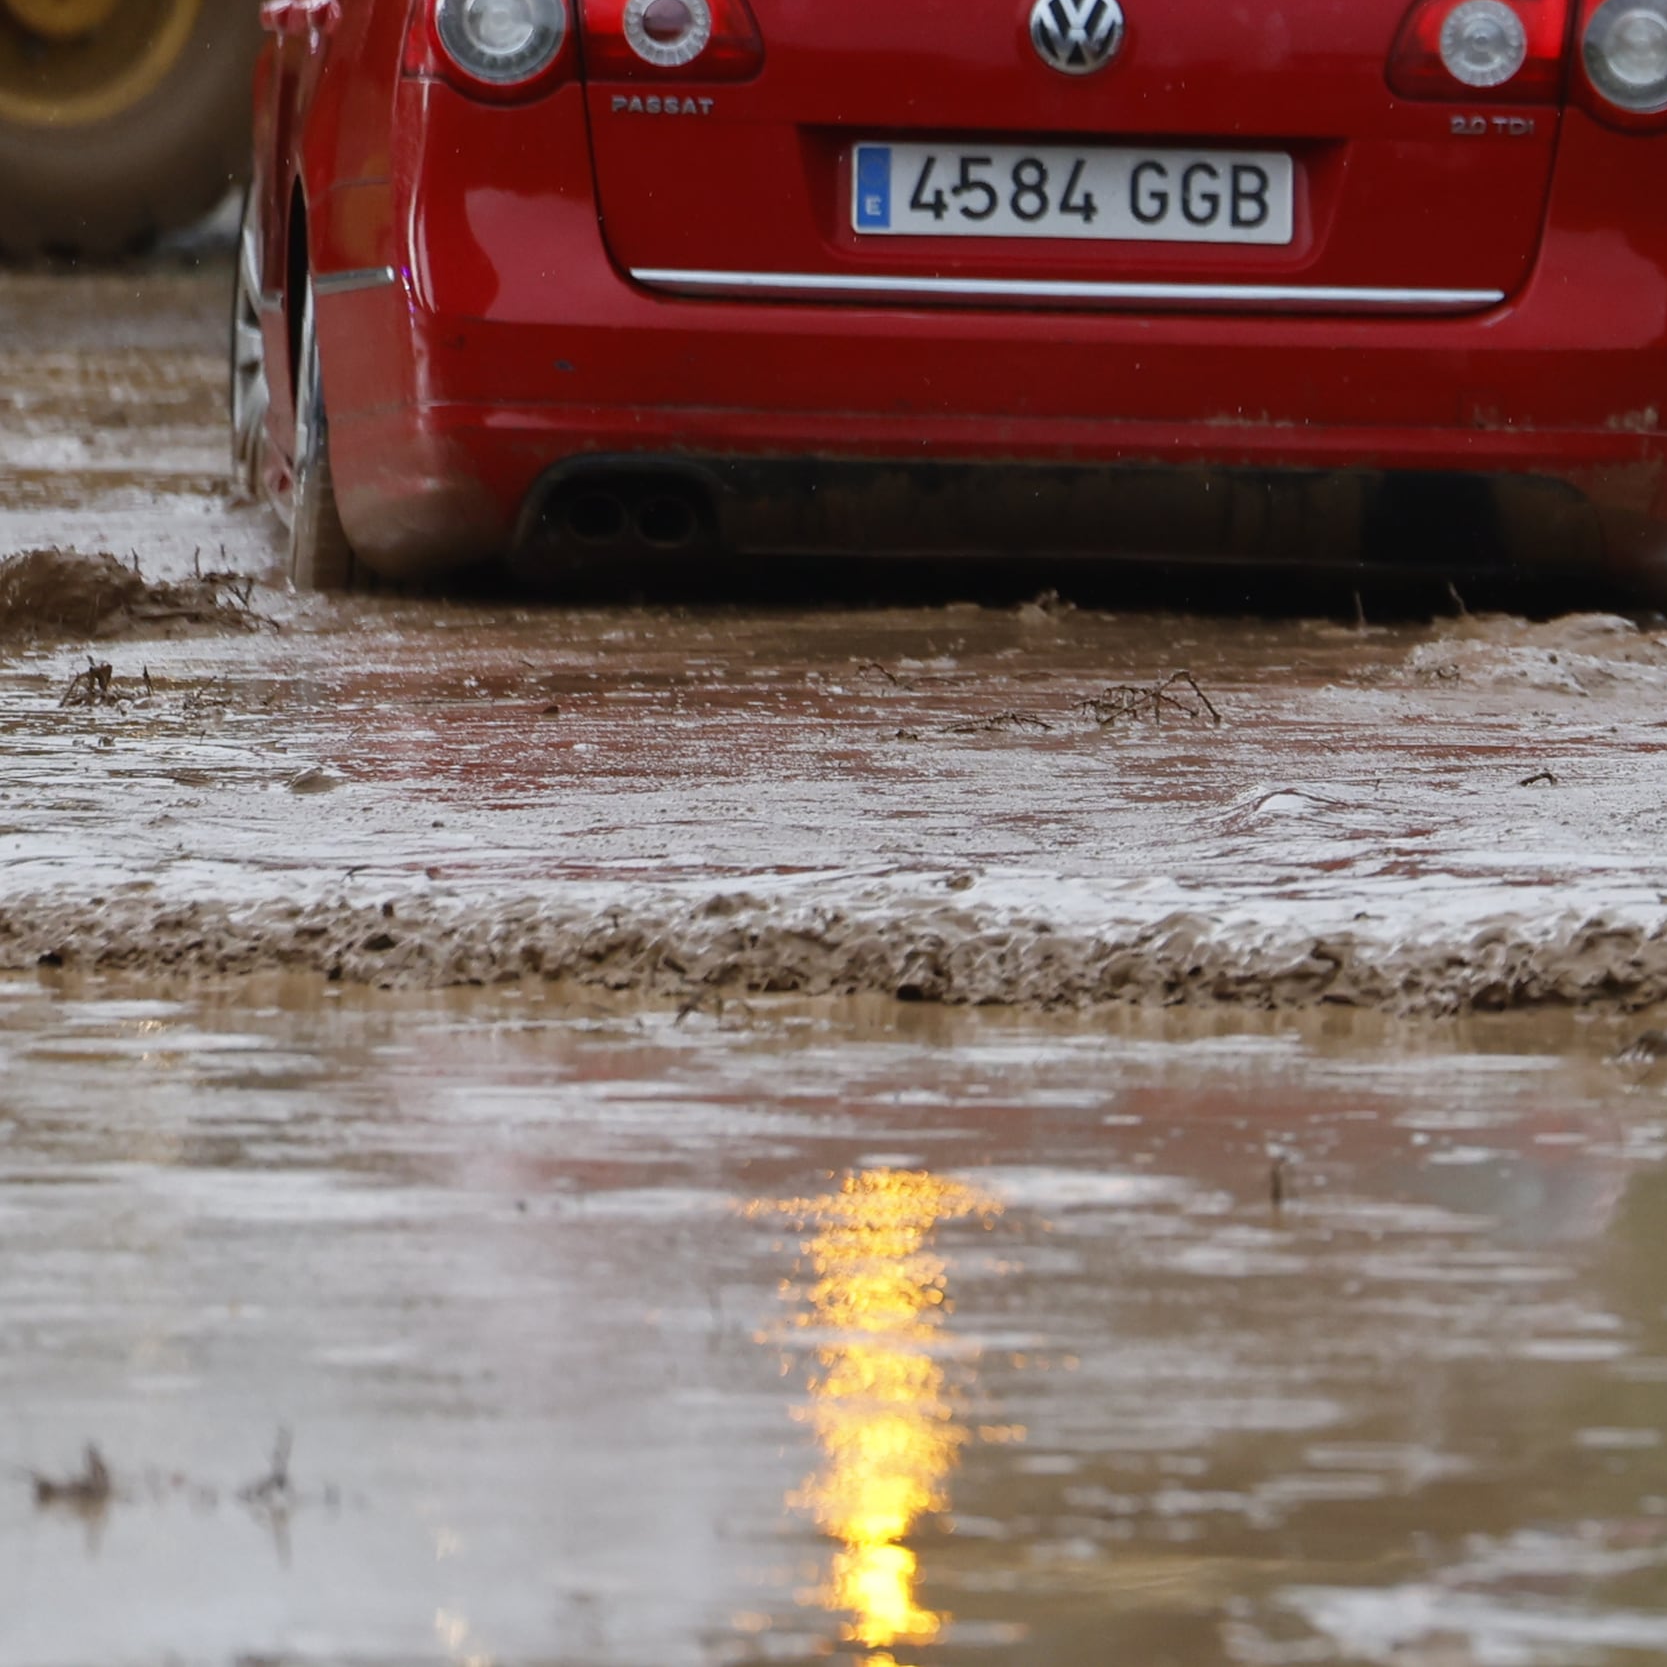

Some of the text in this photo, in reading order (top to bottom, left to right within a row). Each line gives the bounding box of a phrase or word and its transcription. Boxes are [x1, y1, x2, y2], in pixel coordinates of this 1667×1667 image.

[611, 95, 714, 115] PASSAT
[1491, 116, 1535, 135] TDI
[864, 155, 1270, 229] E 4584 GGB
